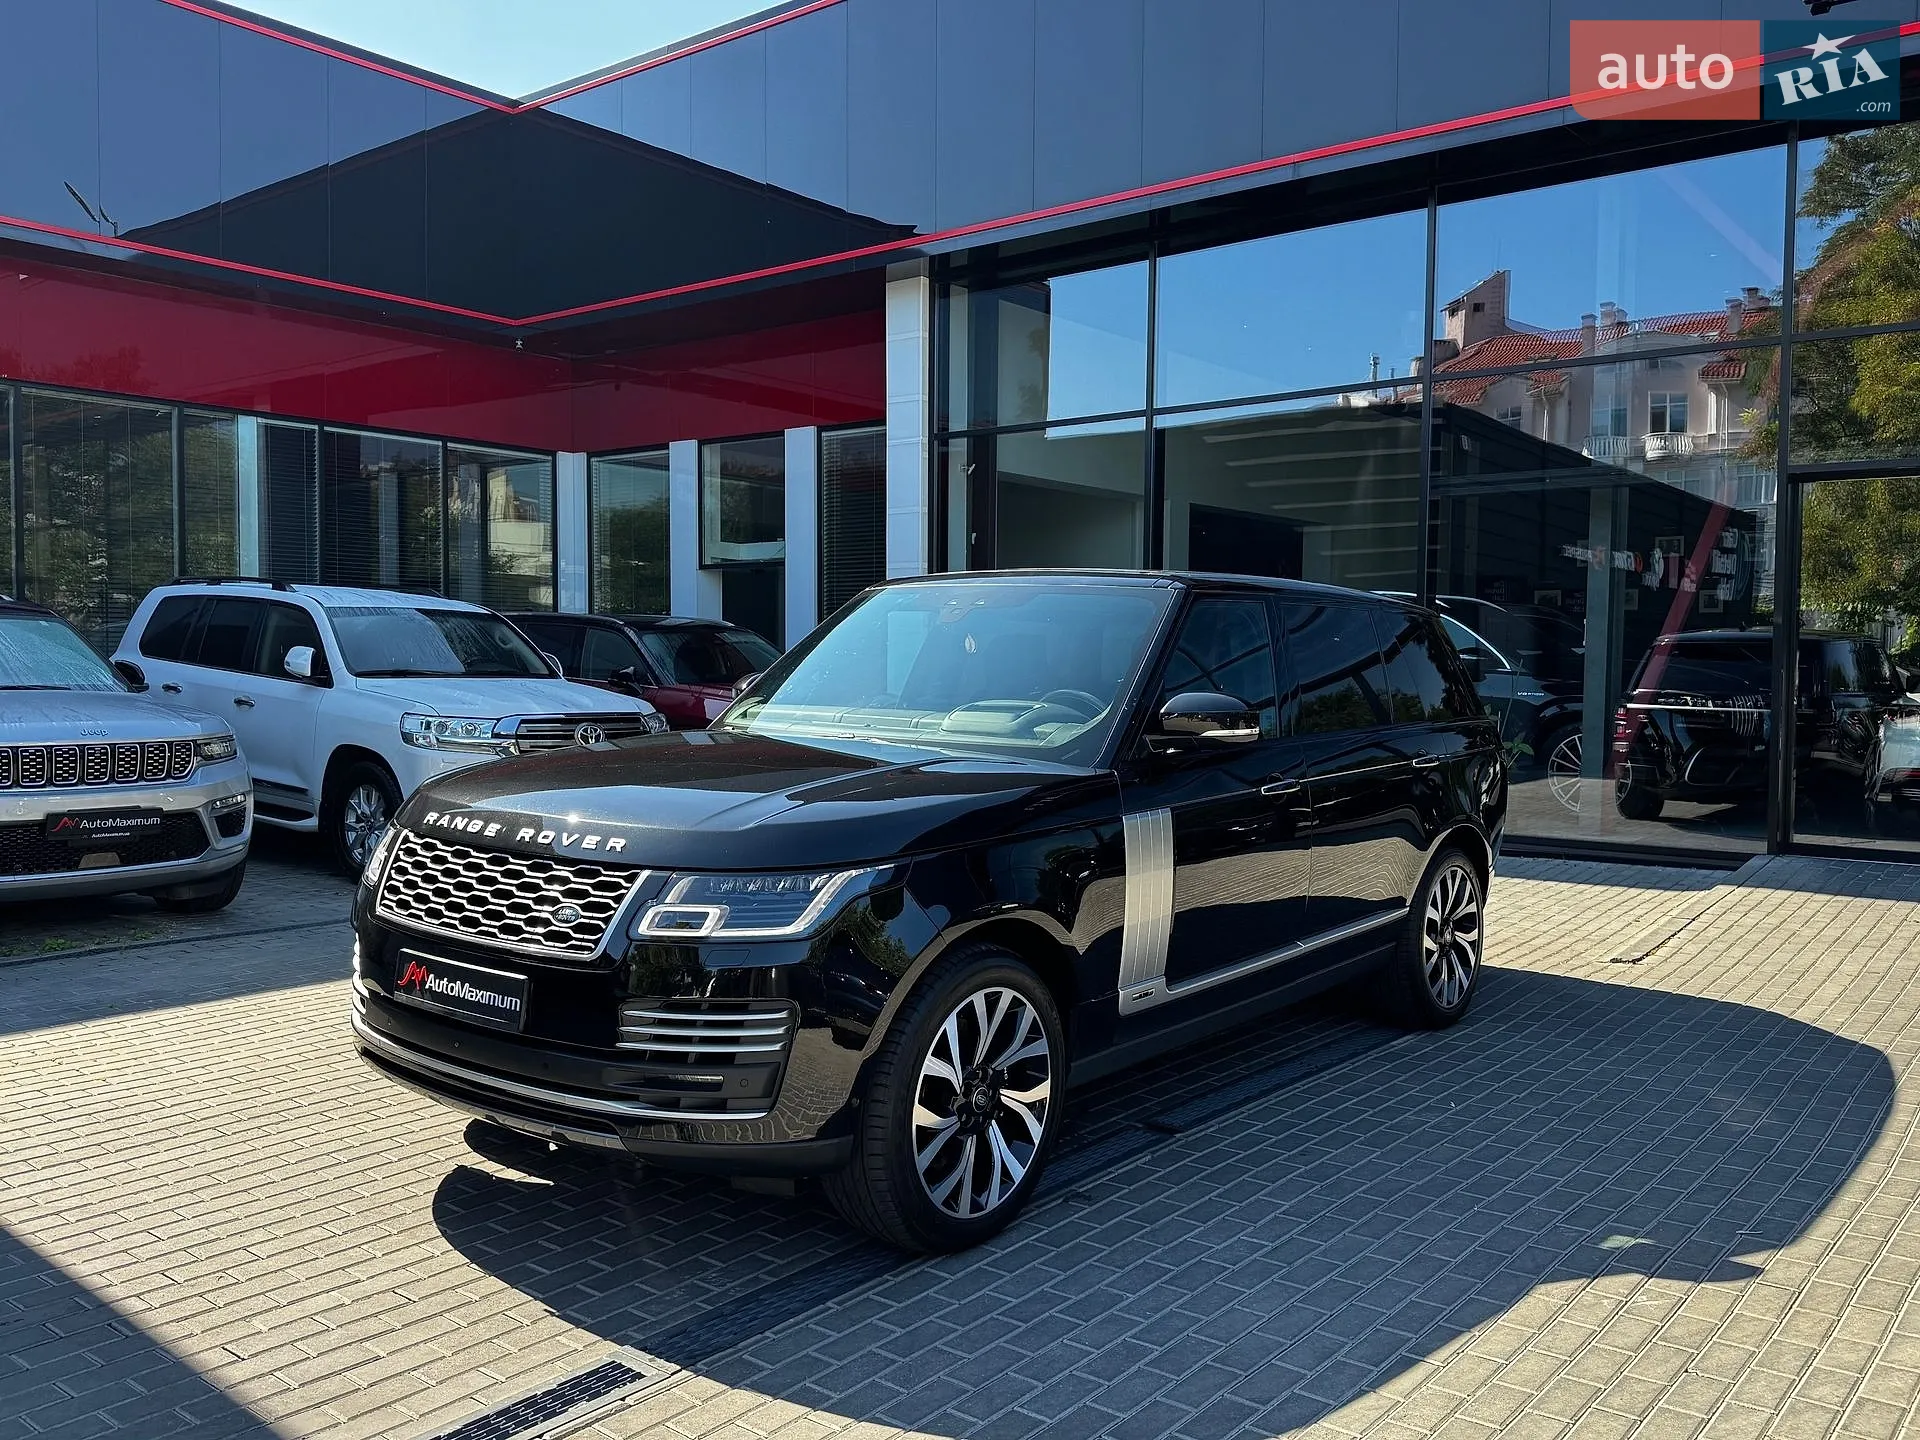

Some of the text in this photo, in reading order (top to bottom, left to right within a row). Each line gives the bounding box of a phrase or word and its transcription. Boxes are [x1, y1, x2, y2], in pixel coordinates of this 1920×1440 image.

[80, 729, 109, 737] Jeep
[79, 817, 161, 829] AutoMaximum
[423, 811, 627, 853] RANGE ROVER
[425, 973, 521, 1012] AutoMaximum
